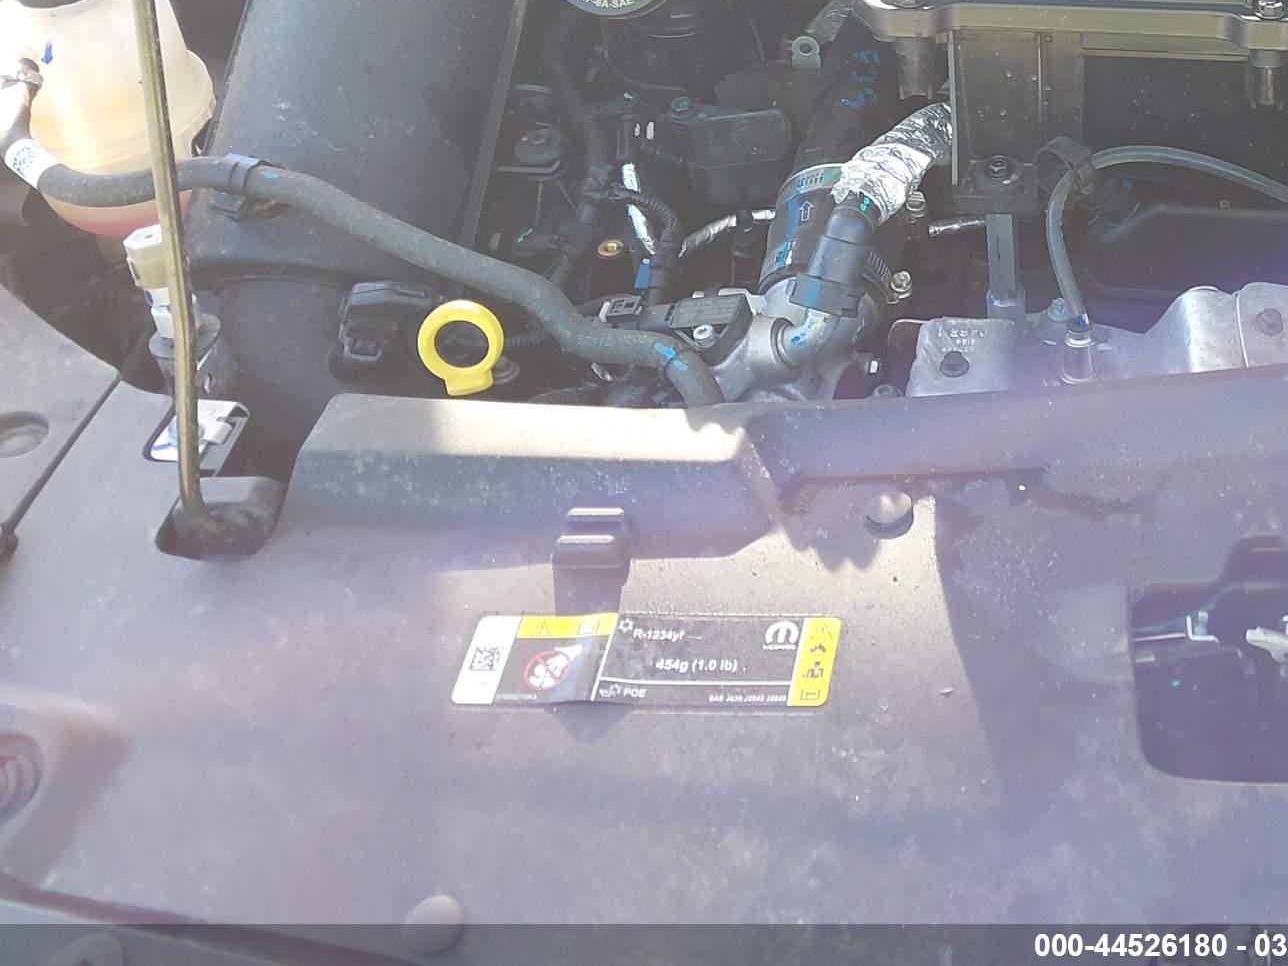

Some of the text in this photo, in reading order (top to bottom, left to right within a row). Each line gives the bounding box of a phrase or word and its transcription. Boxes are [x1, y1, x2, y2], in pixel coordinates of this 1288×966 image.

[632, 628, 684, 642] R-1234yf
[655, 658, 738, 674] 454g (1.0 lb)
[623, 687, 647, 698] POE
